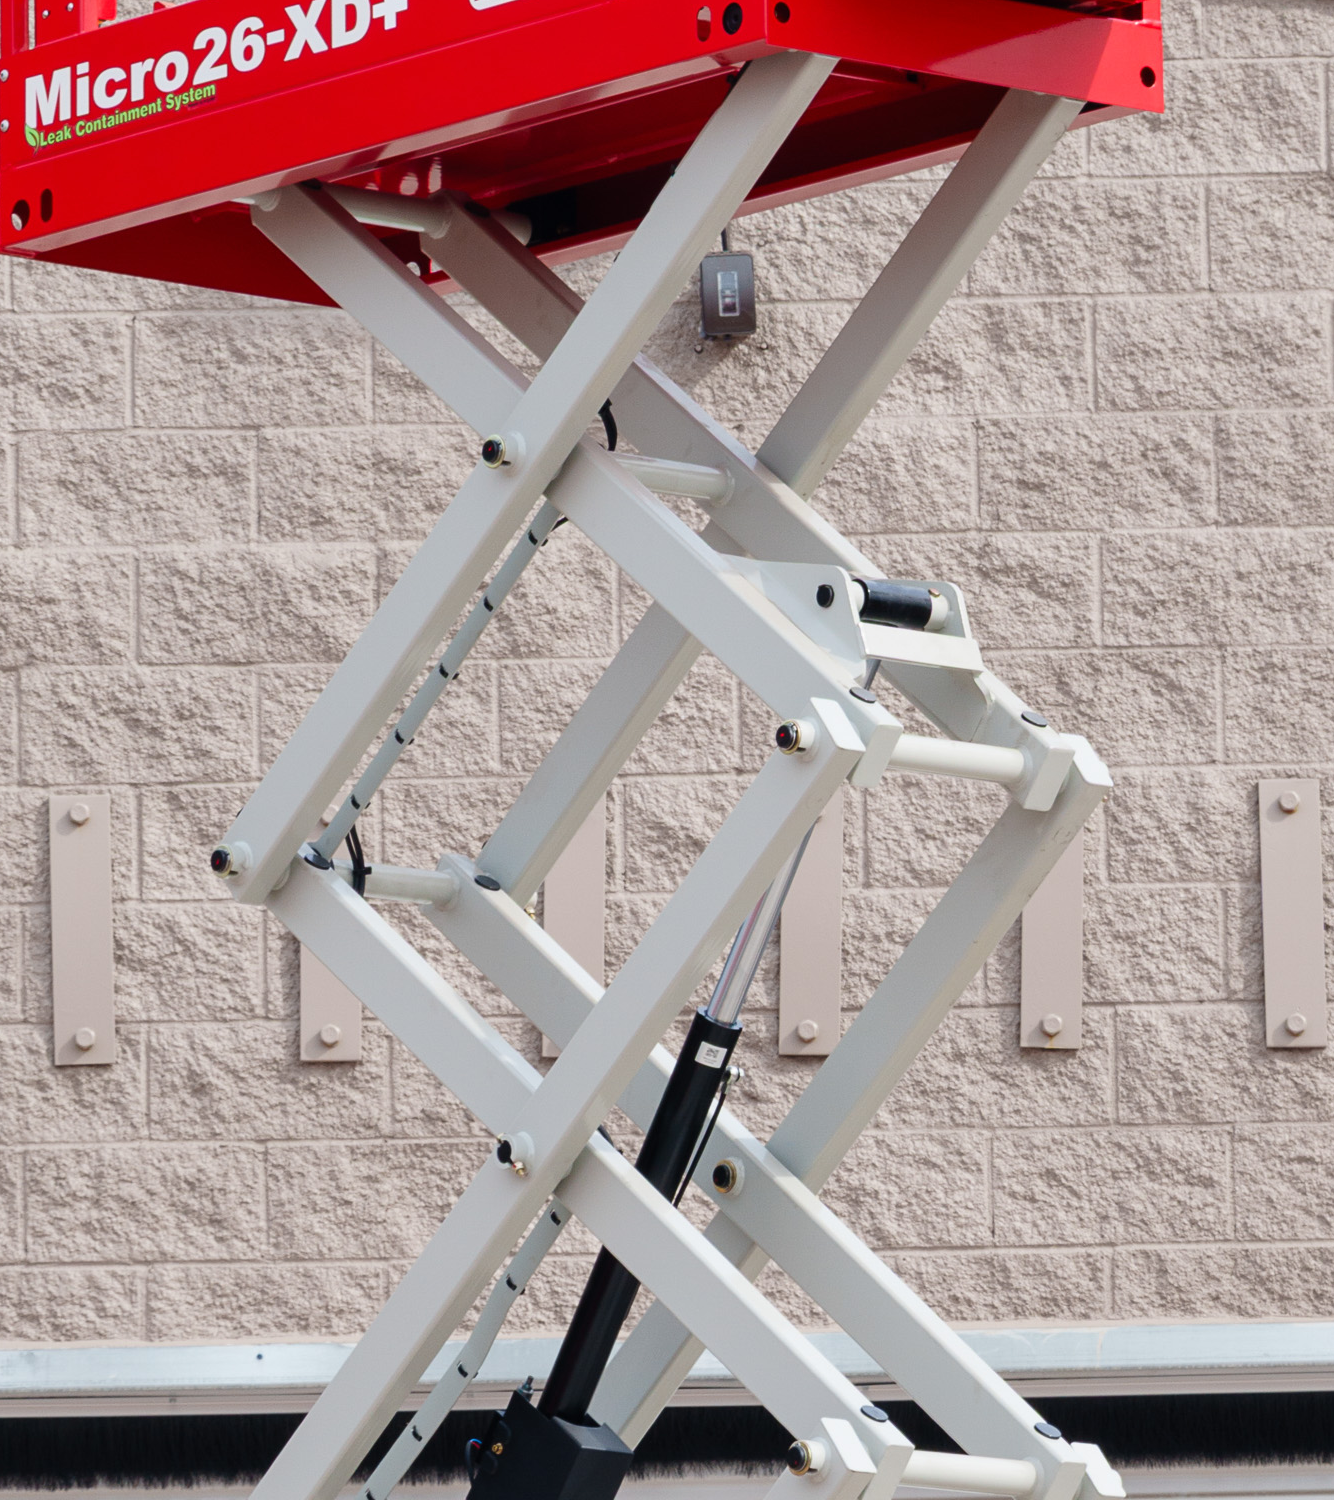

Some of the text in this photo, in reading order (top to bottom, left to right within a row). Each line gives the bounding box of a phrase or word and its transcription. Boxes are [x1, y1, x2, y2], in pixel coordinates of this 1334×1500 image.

[39, 125, 72, 147] Leak
[75, 98, 163, 137] Containment
[165, 84, 217, 112] System
